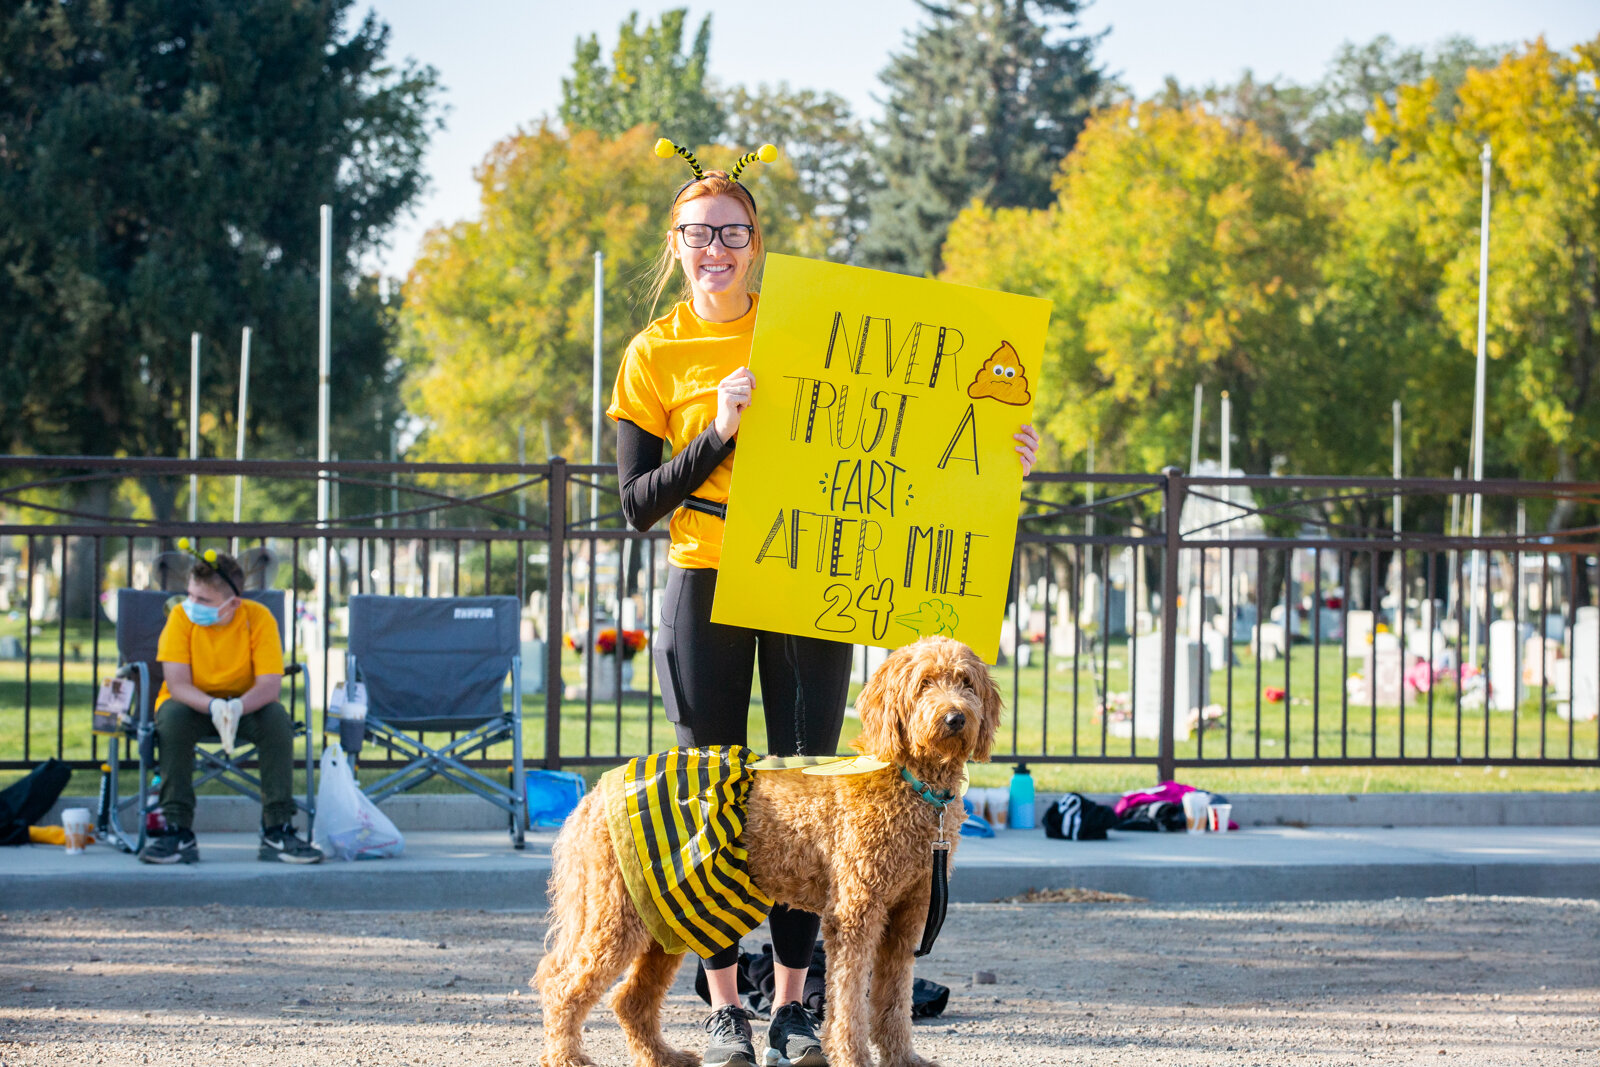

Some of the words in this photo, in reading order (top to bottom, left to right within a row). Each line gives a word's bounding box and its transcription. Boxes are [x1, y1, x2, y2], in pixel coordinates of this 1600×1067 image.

[825, 312, 964, 391] NEVER
[783, 375, 919, 457] TRUST
[937, 403, 979, 475] A
[830, 459, 906, 517] FART
[755, 509, 882, 582] AFTER
[815, 578, 894, 640] 24
